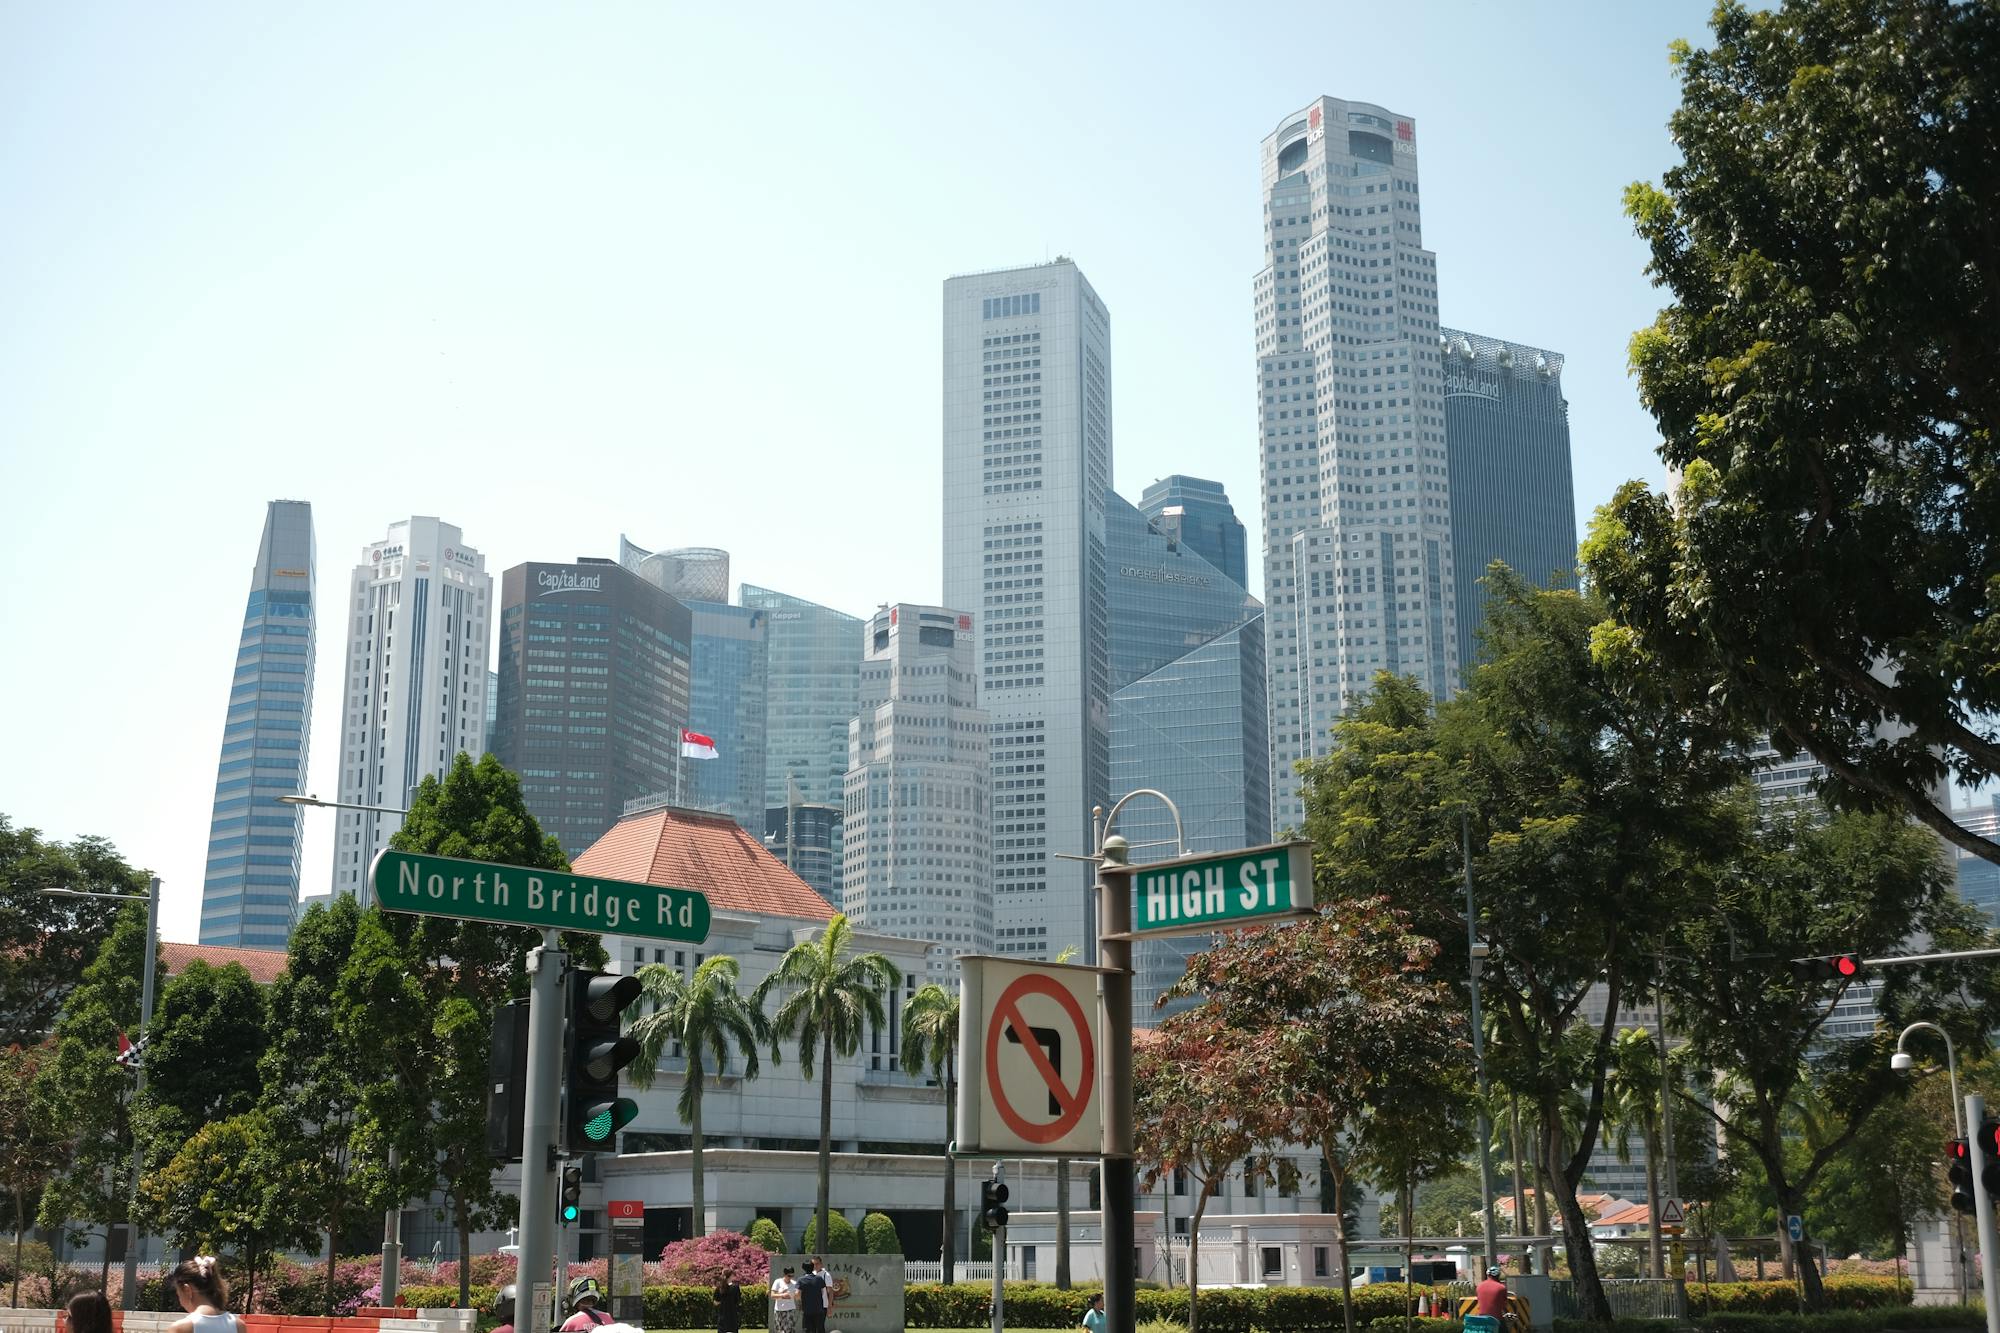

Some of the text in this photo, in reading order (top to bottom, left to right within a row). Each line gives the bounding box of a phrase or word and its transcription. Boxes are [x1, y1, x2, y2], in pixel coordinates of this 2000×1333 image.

[1307, 128, 1324, 146] UOB
[1394, 141, 1416, 155] UOB
[538, 570, 600, 590] CapitaLand
[954, 630, 974, 642] UOB
[399, 860, 692, 928] North Bridge Rd
[1147, 858, 1280, 922] HIGH ST
[827, 1263, 878, 1287] IAMENT
